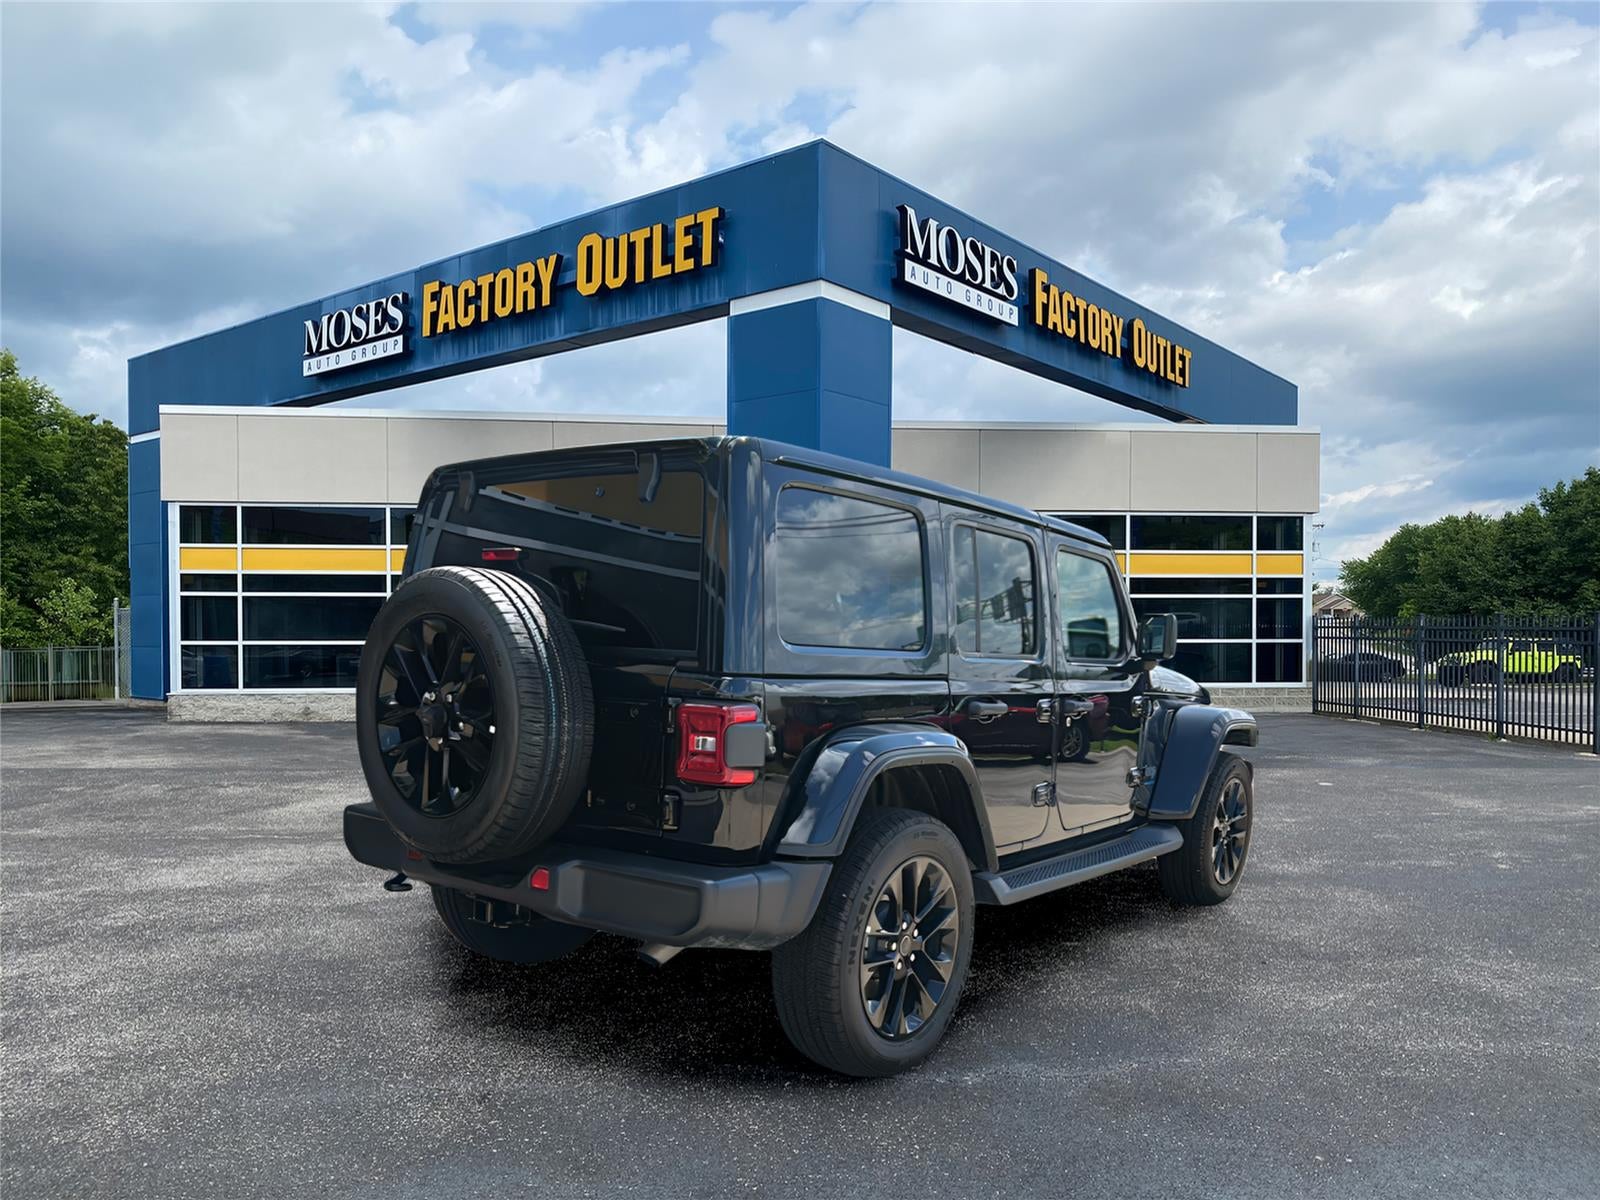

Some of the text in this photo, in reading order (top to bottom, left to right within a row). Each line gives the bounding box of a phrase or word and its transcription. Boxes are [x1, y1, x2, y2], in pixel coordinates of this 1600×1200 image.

[421, 206, 720, 337] FACTORY OUTLET
[904, 204, 1018, 300] MOSES
[910, 265, 1014, 319] AUTO GROUP
[303, 293, 404, 356] MOSES
[307, 339, 399, 372] AUTO GROUP
[1034, 267, 1192, 388] FACTORY OUTLET
[847, 885, 874, 966] NEXEN
